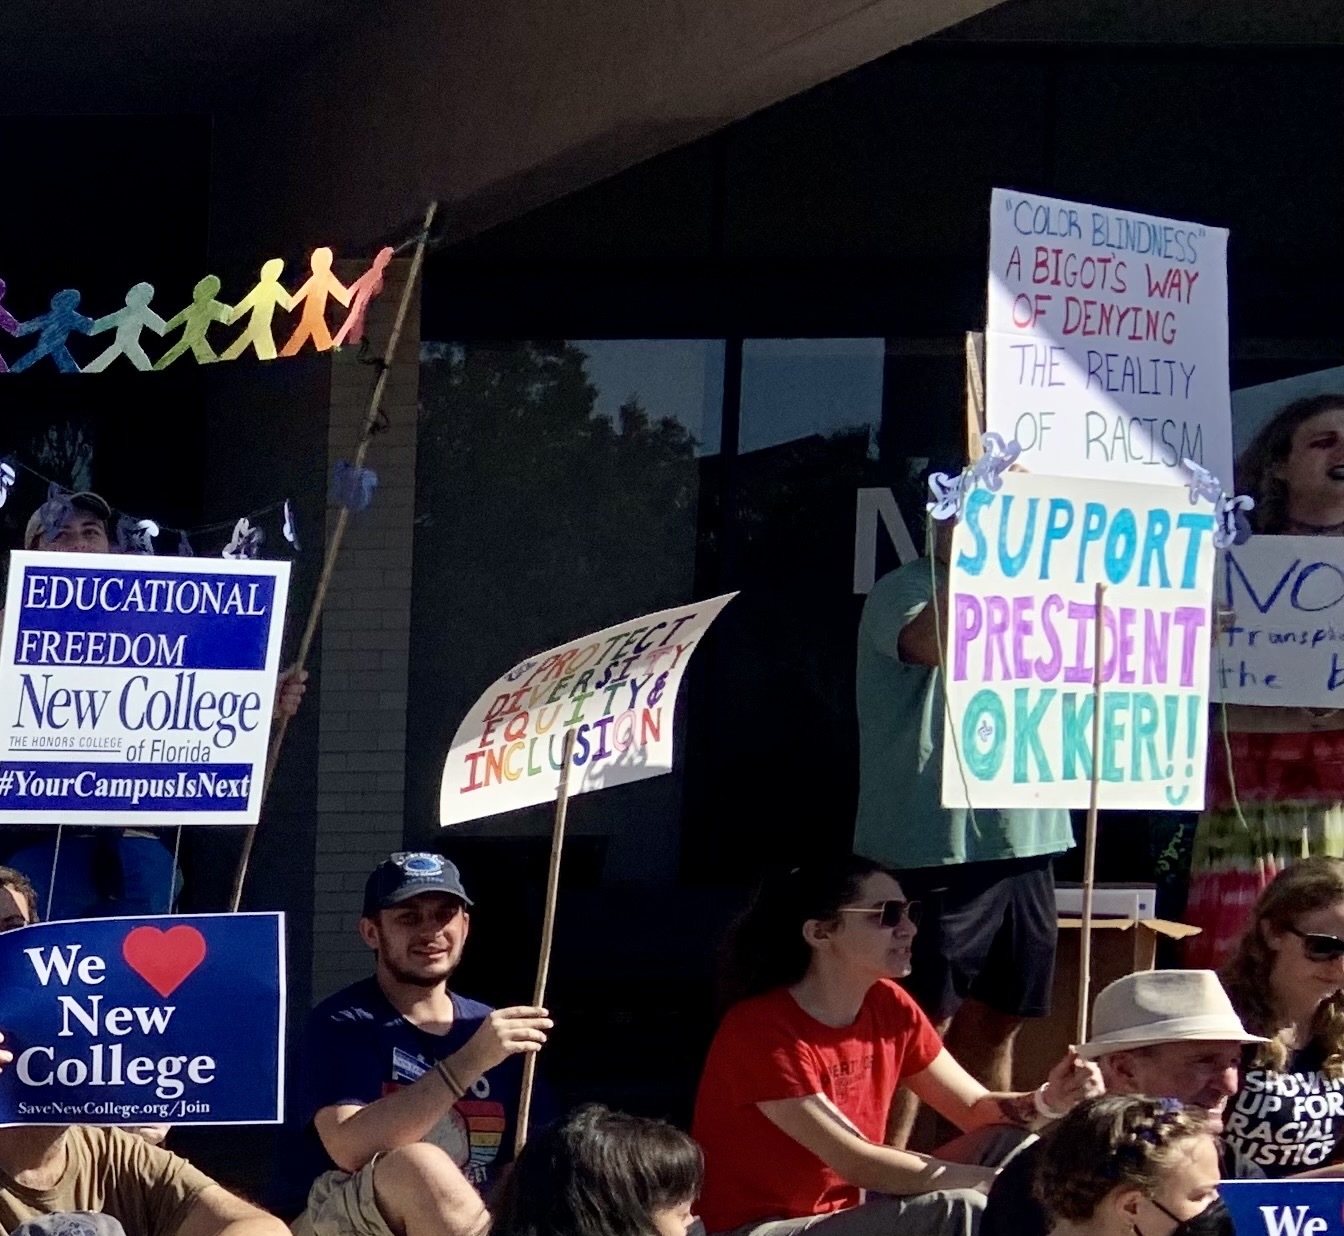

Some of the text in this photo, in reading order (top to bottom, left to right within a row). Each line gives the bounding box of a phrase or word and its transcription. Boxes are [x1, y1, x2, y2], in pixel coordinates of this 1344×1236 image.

[1005, 247, 1022, 281] A
[1146, 262, 1199, 303] WAY
[1012, 293, 1177, 345] OF DENYING
[1010, 343, 1196, 399] THE REALITY
[1016, 411, 1204, 467] OF RACISM
[956, 488, 1214, 590] SUPPORT
[25, 574, 267, 617] EDUCATIONAL
[18, 628, 188, 667] FREEDOM
[521, 613, 698, 689] PROTECT
[953, 593, 1206, 688] PRESIDENT
[483, 640, 694, 723] DIVERSITY
[12, 671, 262, 749] New College
[479, 670, 670, 749] EQUITY &
[9, 735, 123, 750] THE HONORS COLLEGE
[125, 739, 211, 764] of Florida
[460, 707, 662, 795] INCLUSION
[24, 943, 106, 987] We
[57, 995, 176, 1037] New
[16, 1047, 216, 1100] College
[17, 1099, 211, 1118] SaveNewCollege.org/Join
[1225, 1112, 1334, 1144] RACIAL
[1235, 1090, 1344, 1123] UP FOR
